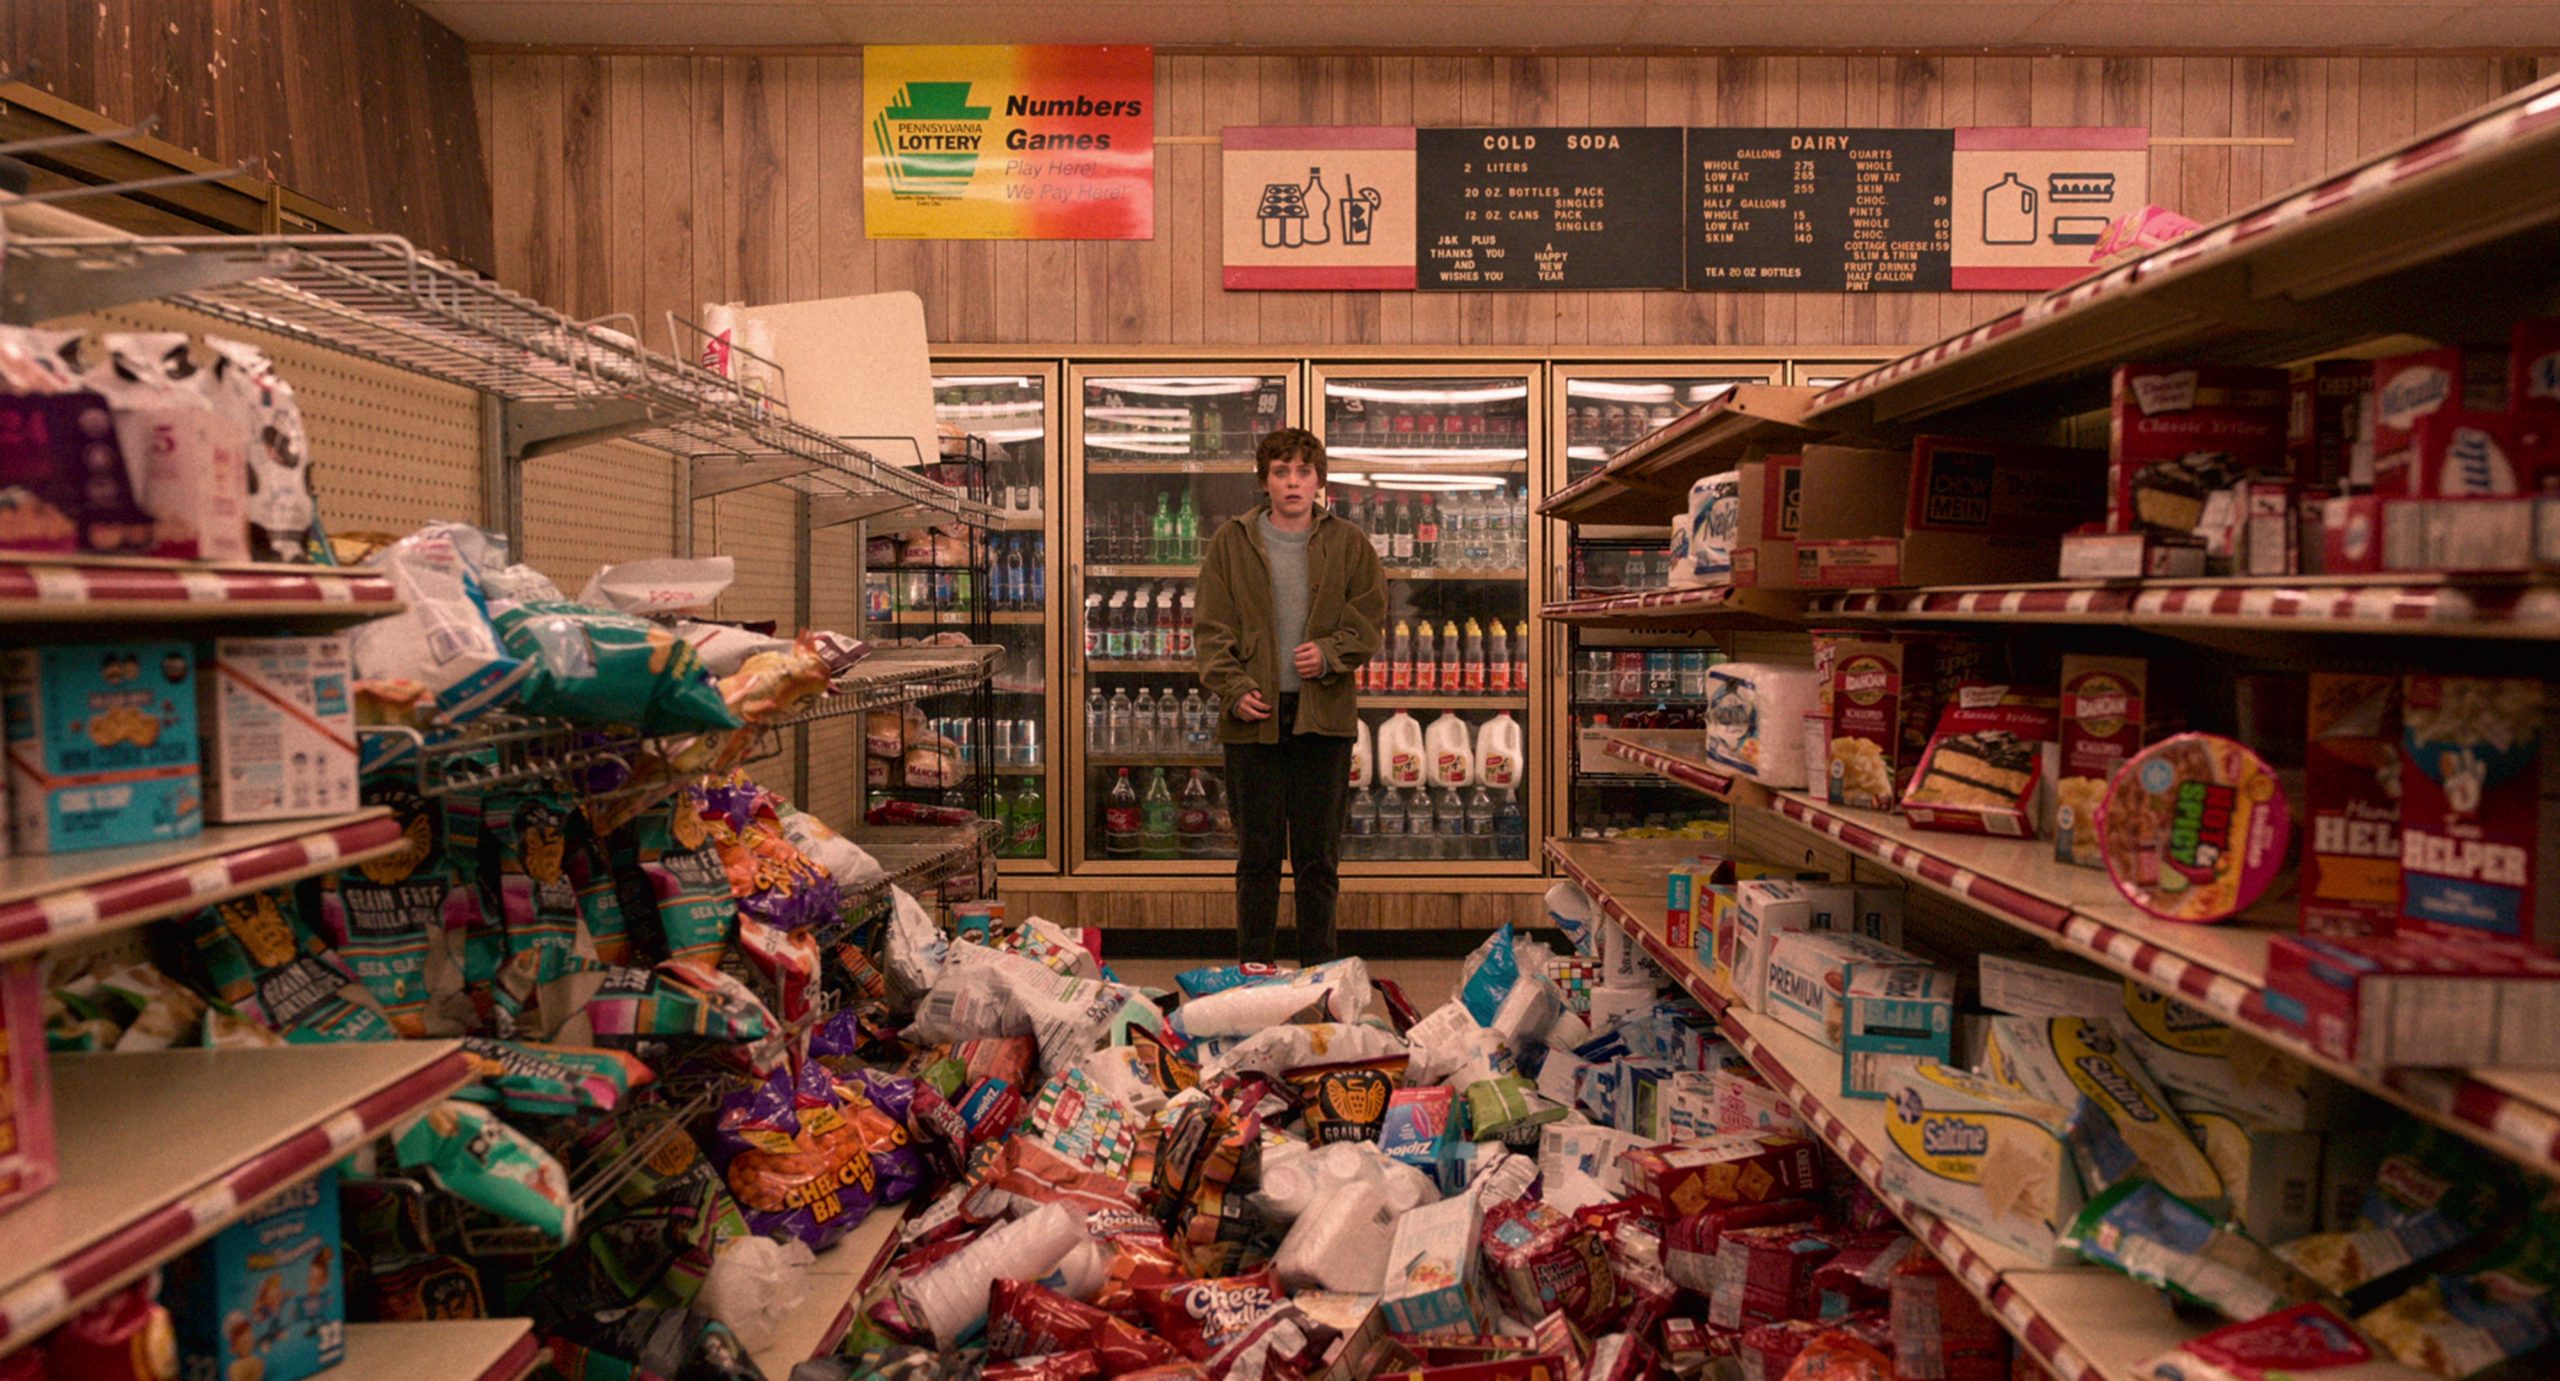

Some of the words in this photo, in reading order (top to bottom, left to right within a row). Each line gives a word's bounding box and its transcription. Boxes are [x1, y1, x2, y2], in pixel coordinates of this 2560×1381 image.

[1005, 95, 1142, 117] Numbers
[898, 123, 982, 133] PENNSYLVANIA
[899, 135, 982, 150] LOTTERY
[1005, 128, 1111, 150] Games
[1484, 135, 1536, 150] COLD
[1567, 135, 1620, 149] SODA
[1791, 136, 1849, 150] DAIRY
[1737, 149, 1781, 159] GALLONS
[1850, 150, 1892, 159] QUARTS
[1005, 160, 1043, 178] Play
[1048, 161, 1097, 176] Here!
[1464, 163, 1472, 173] 2
[1487, 163, 1528, 173] LITERS
[1704, 161, 1740, 170] WHOLE
[1794, 161, 1814, 170] 275
[1856, 162, 1893, 171] WHOLE
[1705, 172, 1728, 181] LOW
[1732, 172, 1750, 181] FAT
[1793, 171, 1815, 180] 265
[1856, 173, 1881, 182] LOW
[1884, 173, 1901, 182] FAT
[1005, 184, 1034, 200] We
[1039, 184, 1072, 203] Pay
[1078, 184, 1126, 200] Here!
[1464, 187, 1479, 197] 20
[1509, 187, 1560, 197] BOTTLES
[1575, 187, 1604, 197] PACK
[1704, 184, 1735, 193] SKIM
[1793, 184, 1815, 194] 255
[1856, 185, 1883, 194] SKIM
[1555, 198, 1604, 208] SINGLES
[1704, 199, 1732, 208] HALF
[1740, 199, 1787, 209] GALLONS
[1933, 196, 1947, 205] 89
[1465, 210, 1477, 220] 12
[1509, 210, 1539, 220] CANS
[1554, 210, 1582, 219] PACK
[1704, 210, 1739, 220] WHOLE
[1849, 207, 1882, 217] PINTS
[1555, 221, 1604, 231] SINGLES
[1705, 222, 1729, 231] LOW
[1732, 222, 1749, 231] FAT
[1794, 222, 1812, 231] 145
[1853, 218, 1889, 228] WHOLE
[1934, 219, 1949, 228] 60
[1705, 233, 1734, 243] SKIM
[1794, 233, 1813, 243] 140
[1935, 230, 1949, 239] 65
[1438, 235, 1458, 245] J&K
[1471, 235, 1496, 245] PLUS
[1545, 242, 1552, 251] A
[1844, 241, 1887, 251] COTTAGE
[1890, 241, 1928, 251] CHEESE
[1430, 249, 1473, 258] THANKS
[1485, 249, 1505, 258] YOU
[1534, 252, 1568, 261] HAPPY
[1853, 251, 1879, 260] SLIM
[1883, 251, 1889, 260] &
[1892, 251, 1918, 260] TRIM
[1454, 260, 1476, 270] AND
[1540, 262, 1563, 271] NEW
[1844, 262, 1873, 271] FRUIT
[1879, 262, 1917, 272] DRINKS
[1440, 271, 1479, 281] WISHES
[1484, 271, 1504, 281] YOU
[1538, 271, 1564, 281] YEAR
[1705, 267, 1724, 277] TEA
[1729, 267, 1741, 277] 20
[1744, 267, 1756, 277] OZ
[1761, 267, 1801, 277] BOTTLES
[1847, 272, 1872, 281] HALF
[1875, 272, 1914, 281] GALLON
[1846, 281, 1869, 291] PINT
[1257, 393, 1278, 414] 99
[2138, 418, 2200, 433] Classic
[1934, 475, 1988, 495] CHOW
[1931, 497, 1987, 519] MEIN
[1953, 710, 1999, 722] Classic
[2005, 713, 2049, 725] Yellow
[2402, 828, 2527, 887] HELPER
[357, 961, 391, 976] SEA
[1769, 963, 1825, 1012] PREMIUM
[972, 1087, 999, 1122] Ziploc
[1324, 1126, 1362, 1141] GRAIN
[1924, 1119, 1987, 1154] Saltine
[1383, 1140, 1434, 1156] Ziploc
[1537, 1261, 1560, 1275] Top
[1539, 1261, 1585, 1286] Ramen
[1184, 1284, 1272, 1321] Cheez
